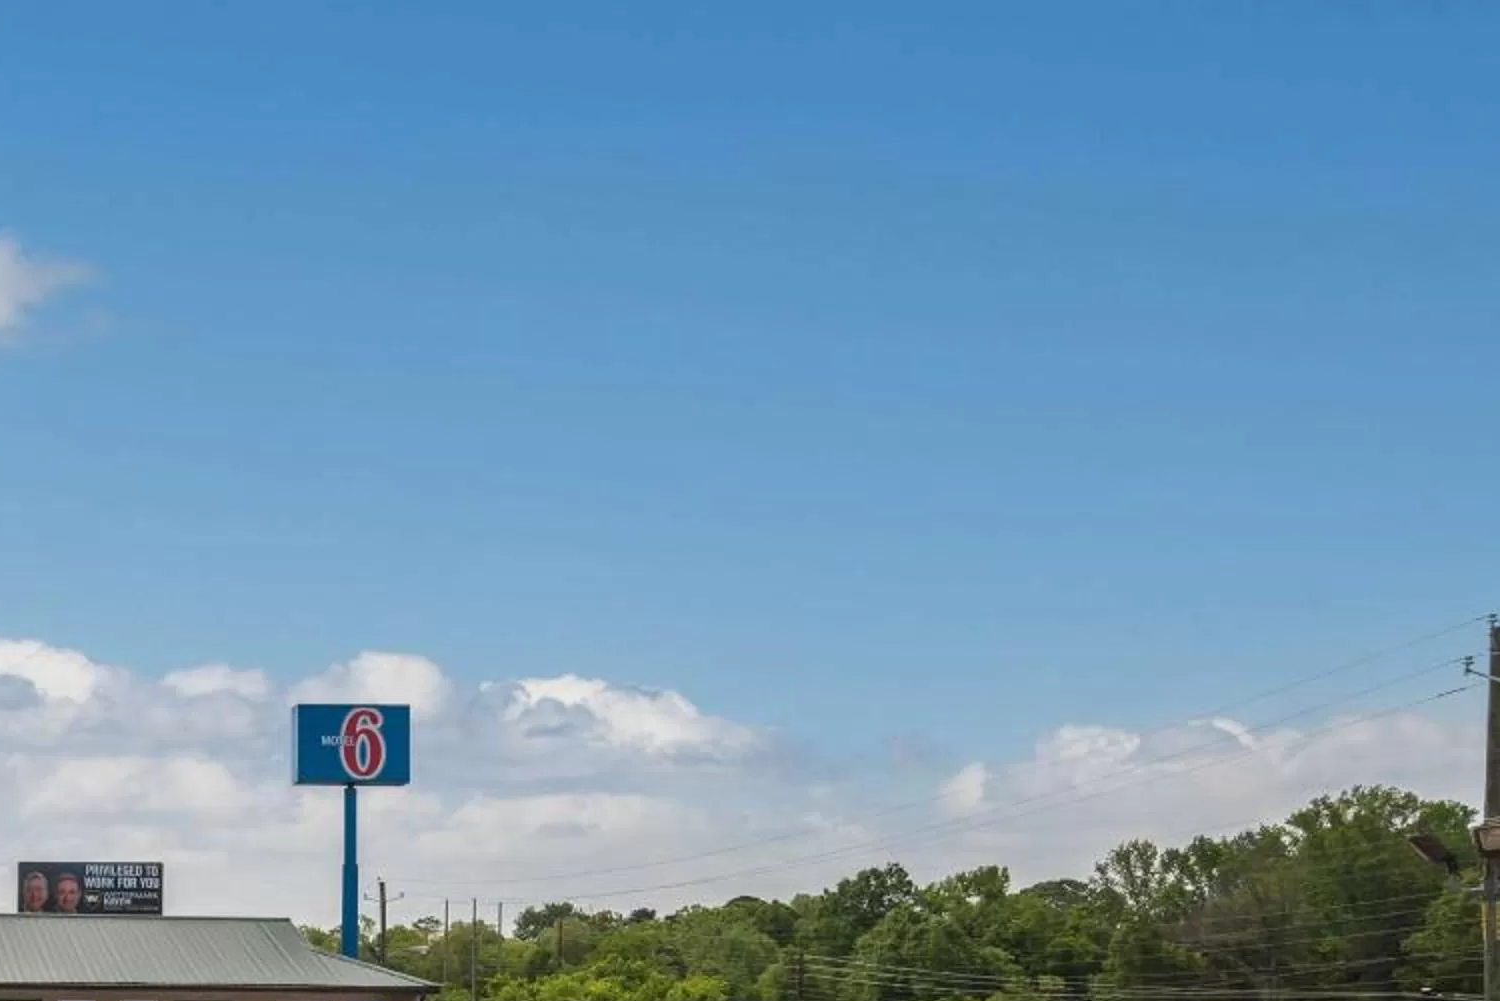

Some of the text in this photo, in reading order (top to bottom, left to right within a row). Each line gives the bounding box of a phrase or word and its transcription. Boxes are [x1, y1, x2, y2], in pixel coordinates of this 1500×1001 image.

[340, 707, 386, 780] 6
[147, 865, 159, 877] TO
[84, 876, 160, 889] WORK FOR YOU
